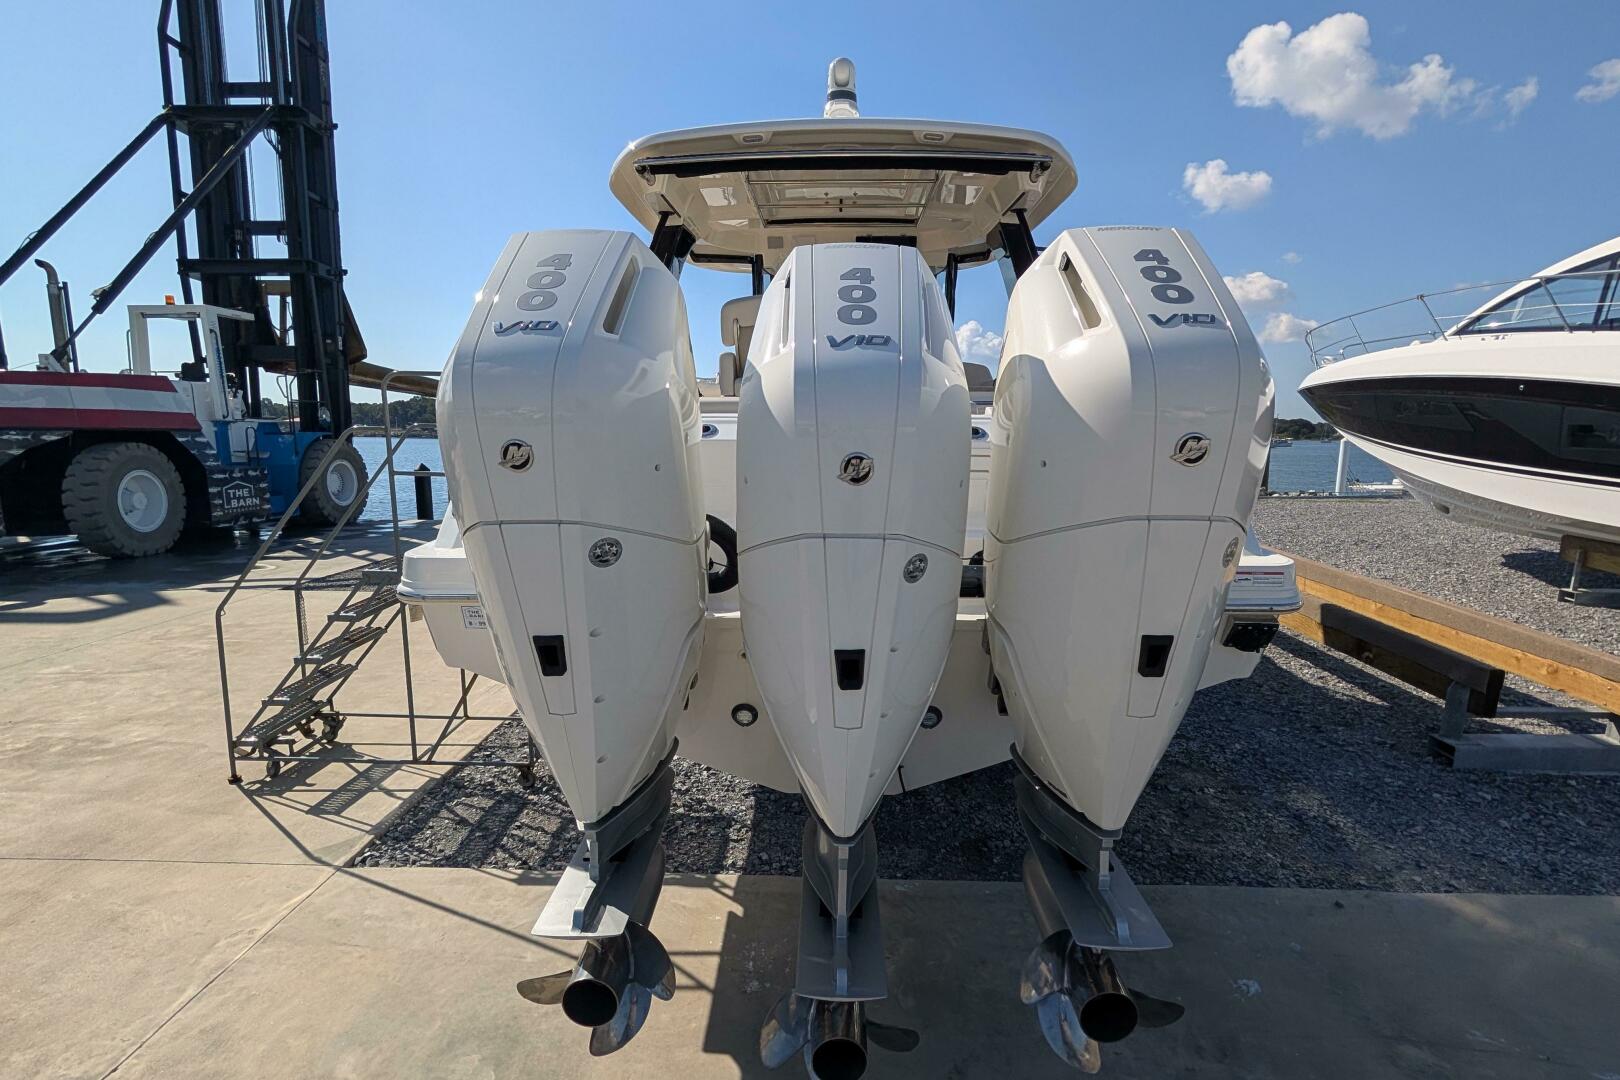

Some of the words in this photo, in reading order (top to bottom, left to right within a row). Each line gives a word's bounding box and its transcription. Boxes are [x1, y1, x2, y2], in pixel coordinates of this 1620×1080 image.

[516, 253, 573, 311] 400
[836, 267, 877, 325] 400
[1133, 248, 1195, 304] 400
[227, 488, 250, 498] THE
[231, 497, 260, 508] BARN
